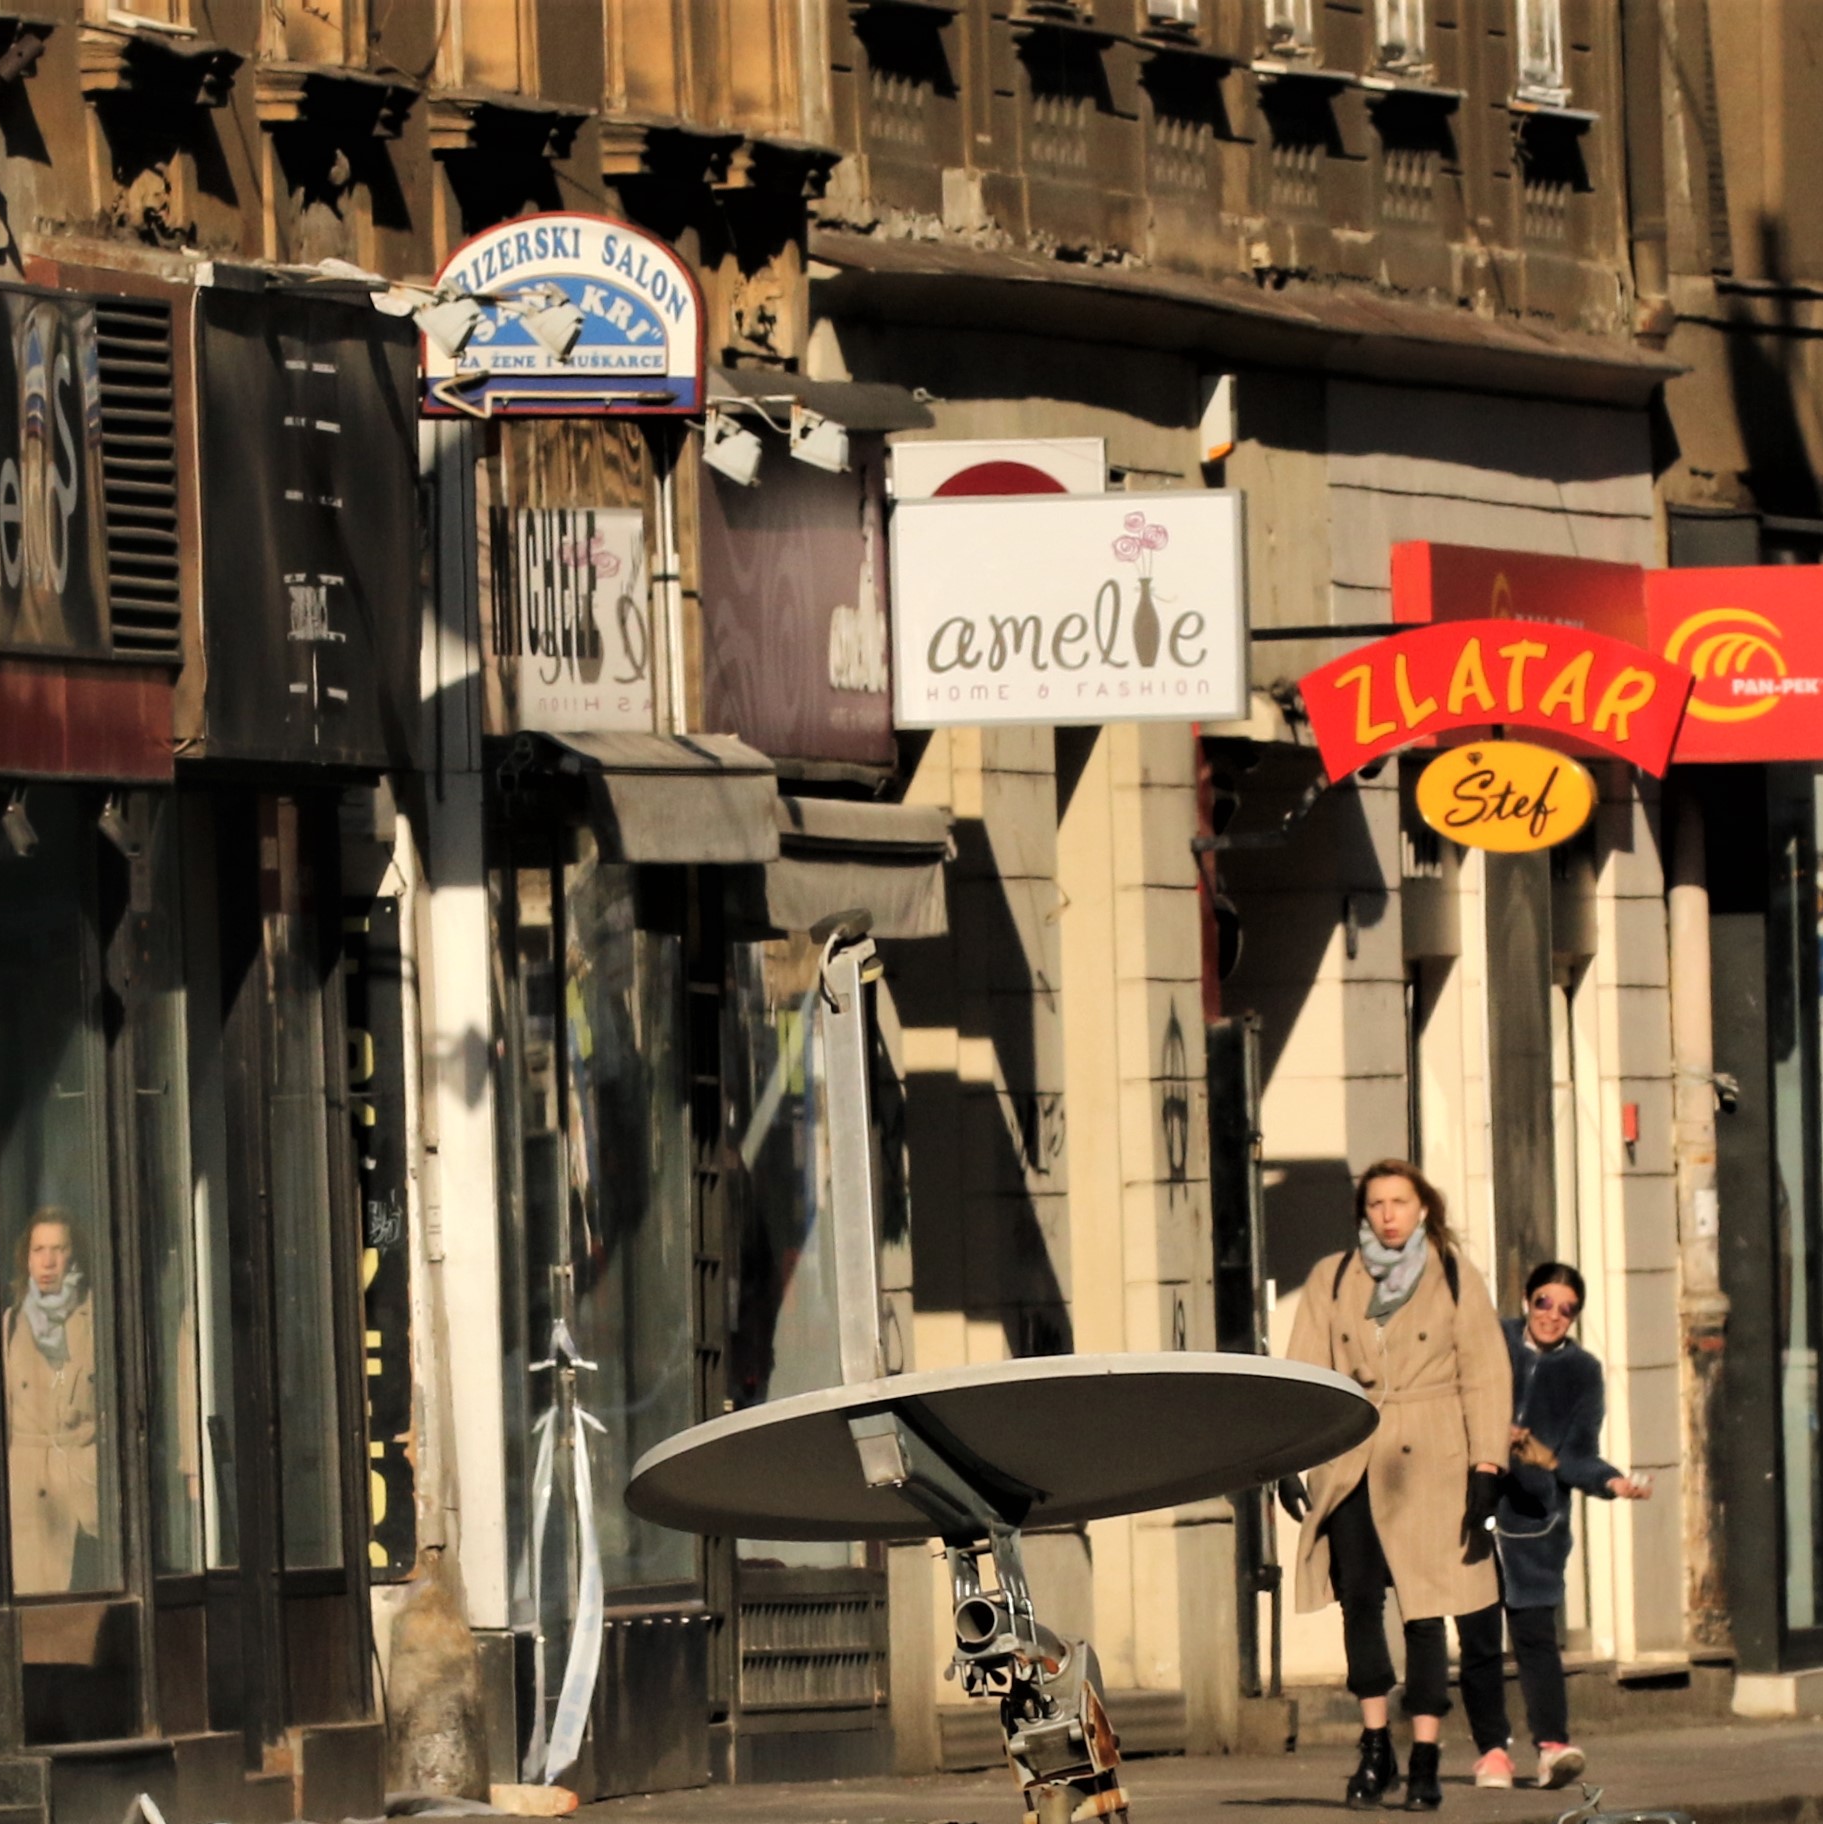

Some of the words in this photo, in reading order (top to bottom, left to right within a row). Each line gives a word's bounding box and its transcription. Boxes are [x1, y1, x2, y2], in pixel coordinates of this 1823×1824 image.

[602, 234, 688, 324] SALON
[459, 355, 481, 369] ZA
[491, 352, 536, 369] ŽENE
[546, 355, 554, 368] I
[1333, 638, 1657, 747] ZLATAR
[1731, 677, 1821, 696] PAN-PEK
